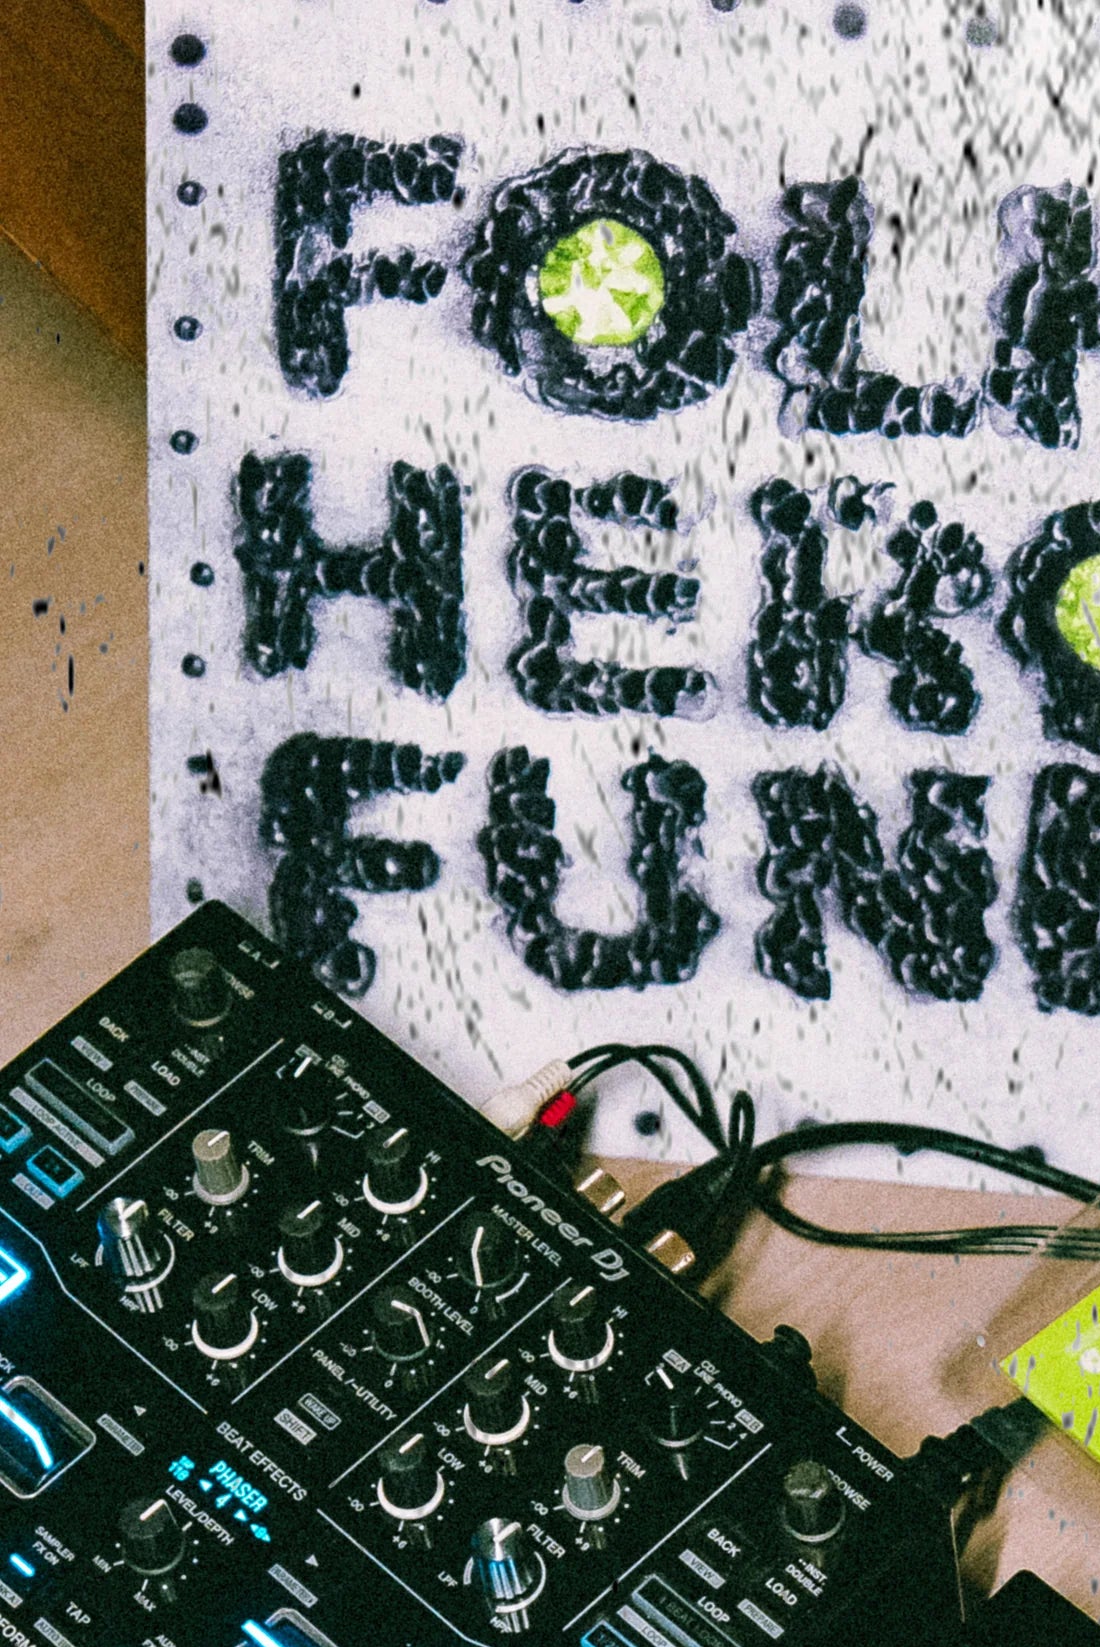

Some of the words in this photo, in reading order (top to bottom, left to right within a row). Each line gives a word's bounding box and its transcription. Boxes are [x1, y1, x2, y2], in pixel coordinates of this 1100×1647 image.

[98, 1016, 130, 1042] BACK
[151, 1060, 181, 1087] LOAD
[85, 1077, 117, 1102] LOOP
[247, 1139, 275, 1167] TRIM
[424, 1149, 443, 1166] HI
[157, 1207, 196, 1243] FILTER
[336, 1216, 362, 1240] MID
[475, 1155, 594, 1248] Pioneer
[590, 1248, 631, 1282] DJ
[490, 1203, 536, 1243] MASTER
[531, 1237, 564, 1268] LEVEL
[250, 1287, 280, 1313] LOW
[407, 1276, 446, 1313] BOOTH
[442, 1306, 477, 1337] LEVEL
[611, 1304, 630, 1321] HI
[311, 1348, 347, 1383] PANEL
[523, 1373, 549, 1397] MID
[713, 1382, 743, 1409] PHONO
[278, 1411, 313, 1443] SHIFT
[215, 1420, 255, 1454] BEAT
[248, 1449, 309, 1503] EFFECTS
[436, 1447, 466, 1473] LOW
[615, 1450, 648, 1480] TRIM
[851, 1445, 895, 1483] POWER
[208, 1459, 269, 1514] PHASER
[165, 1484, 236, 1547] LEVEL/DEPTH
[35, 1525, 76, 1562] SAMPLER
[526, 1523, 567, 1560] FILTER
[706, 1527, 742, 1558] BACK
[689, 1556, 715, 1580] VIEW
[784, 1563, 824, 1597] DOUBLE
[765, 1577, 798, 1606] LOAD
[65, 1600, 92, 1625] TAP
[696, 1595, 731, 1624] LOOP
[743, 1603, 779, 1635] PREPARE
